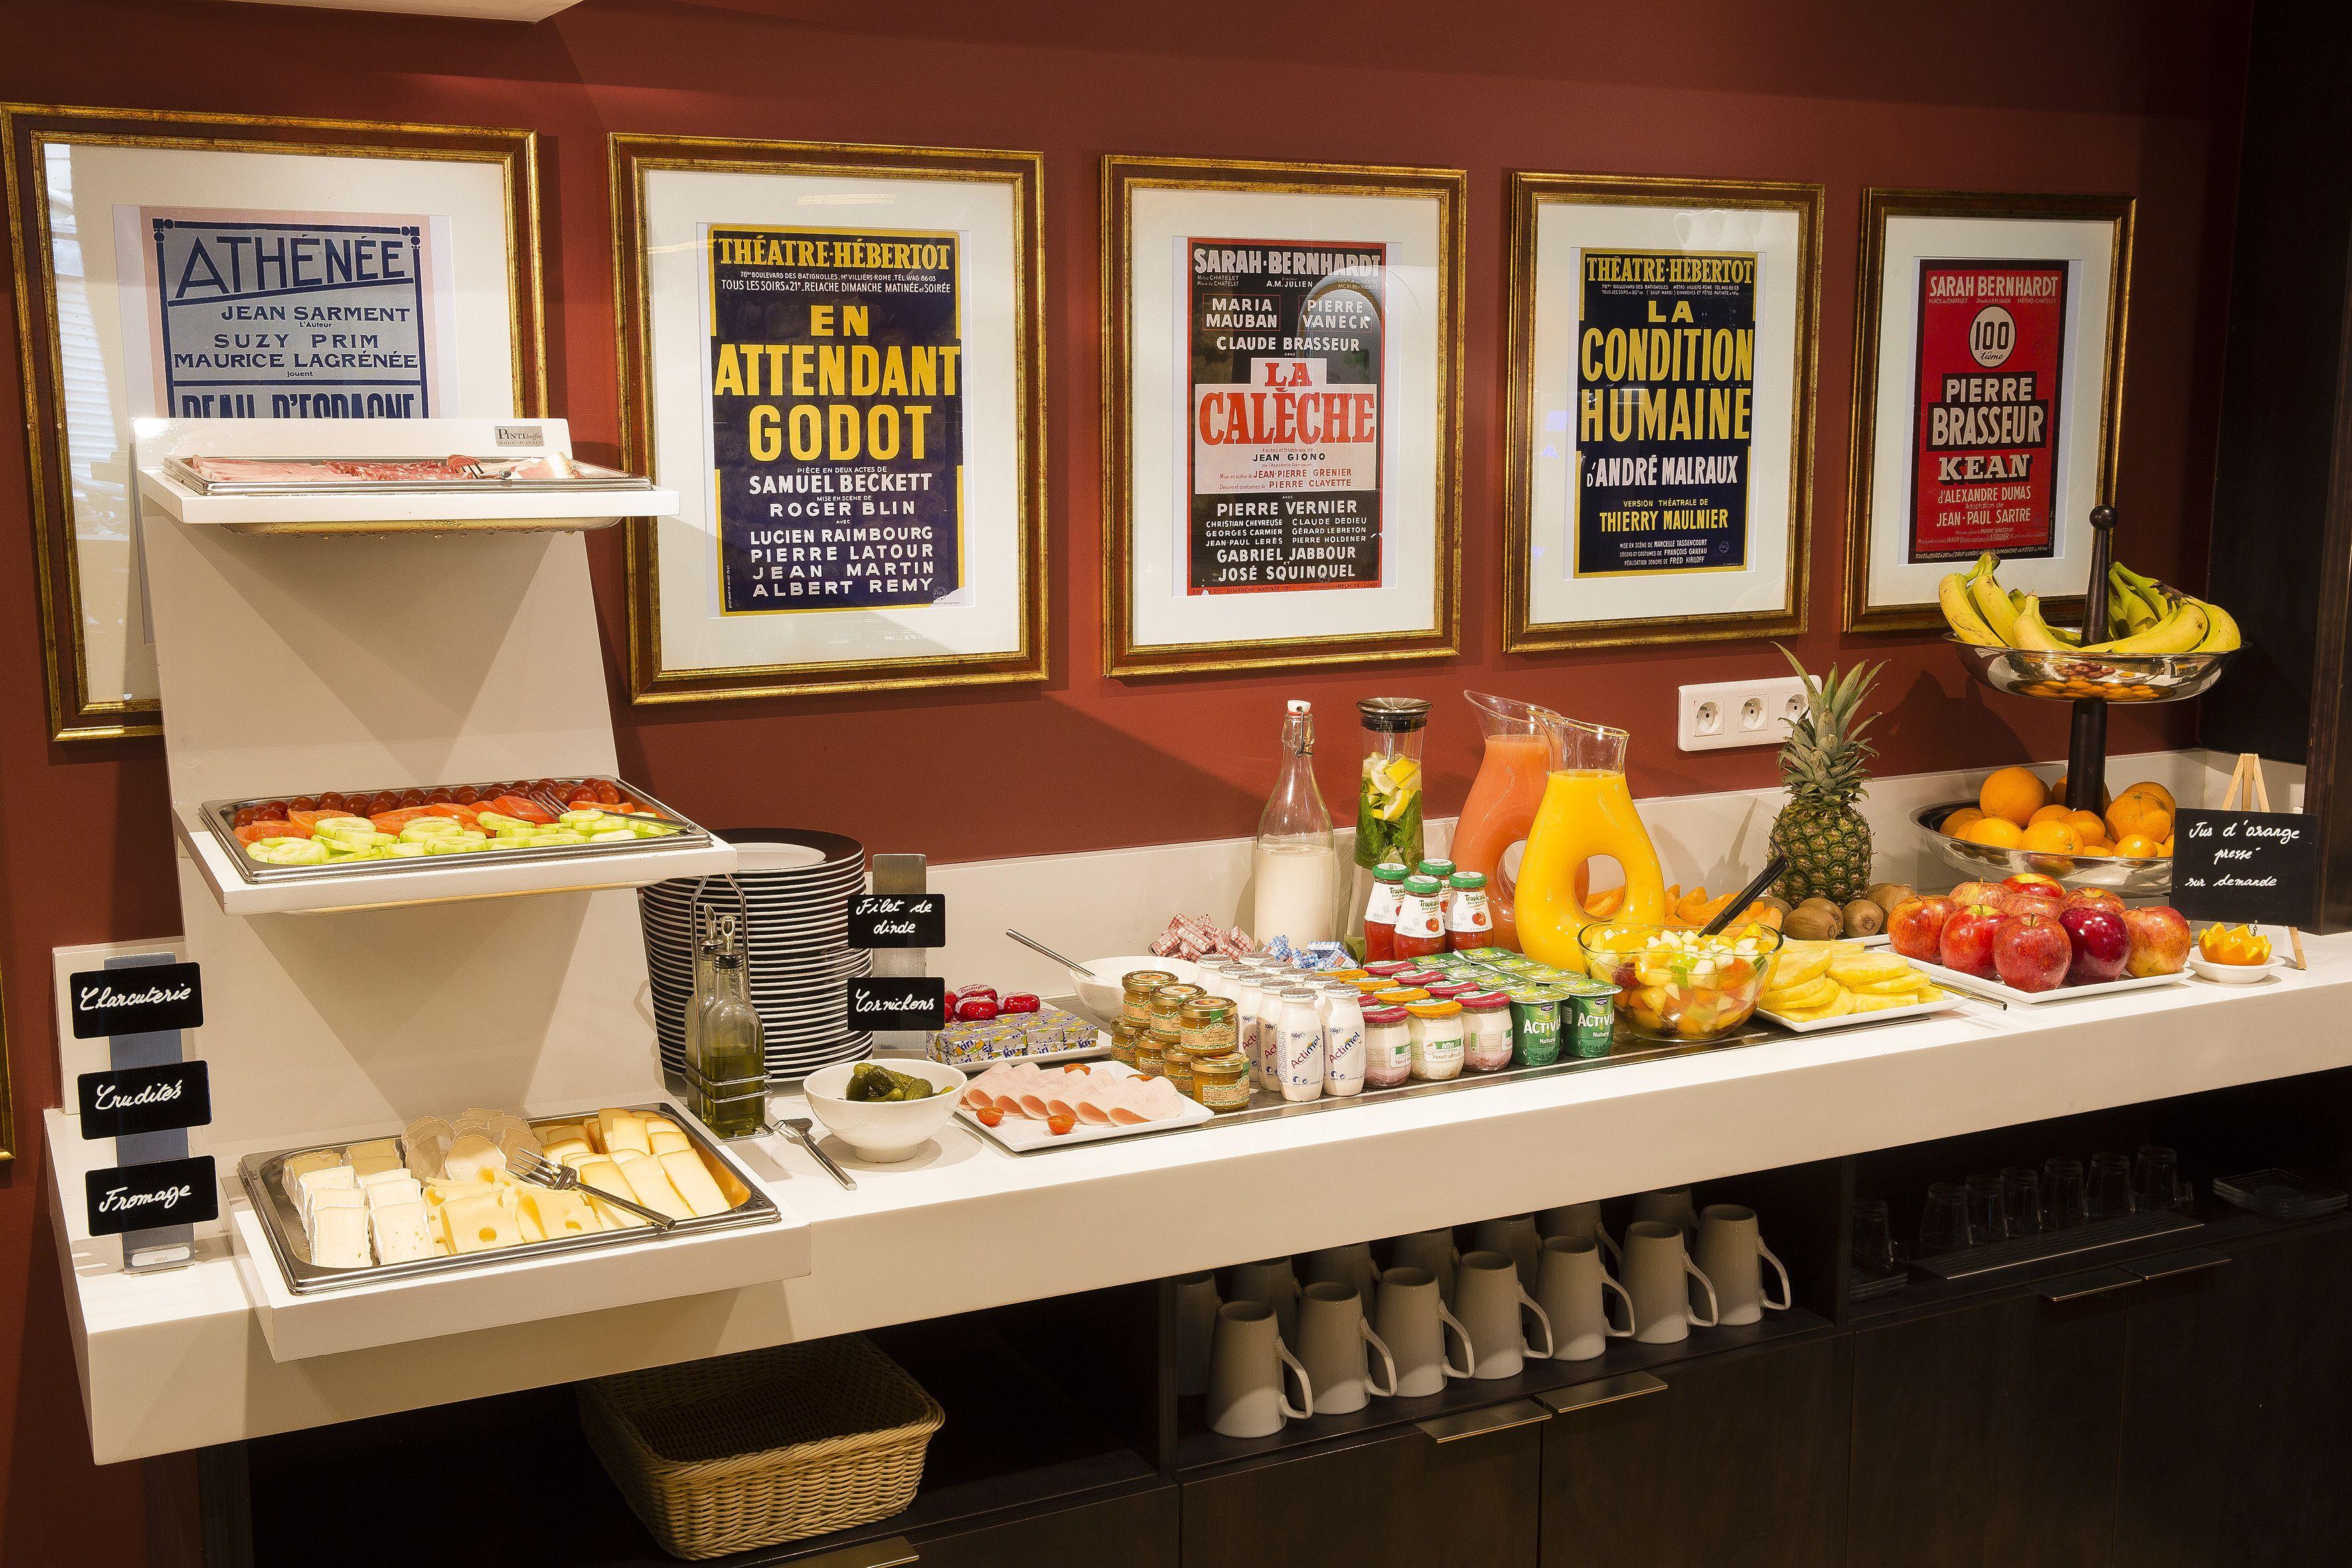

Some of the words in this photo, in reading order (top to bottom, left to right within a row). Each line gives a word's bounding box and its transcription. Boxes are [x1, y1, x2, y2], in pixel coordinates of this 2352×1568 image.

[175, 234, 406, 299] ATHÉNÉE
[722, 279, 744, 290] TOUS
[747, 281, 759, 290] LES
[761, 281, 785, 291] SOIRS
[841, 283, 882, 292] DIMANCHE
[885, 282, 919, 293] MATINÉE
[924, 282, 951, 293] SOIRÉE
[1930, 276, 1974, 297] SARAH
[1977, 276, 2058, 296] BERNHARDT
[221, 305, 285, 321] JEAN
[294, 306, 410, 322] SARMENT
[1212, 298, 1273, 311] MARIA
[1307, 299, 1363, 313] PIERRE
[1648, 301, 1693, 323] LA
[811, 305, 868, 337] EN
[1206, 314, 1277, 328] MAUBAN
[1302, 315, 1369, 329] VANECK
[214, 333, 290, 349] SUZY
[311, 334, 378, 349] PRIM
[1216, 336, 1276, 351] CLAUDE
[1283, 337, 1360, 351] BRASSEUR
[1974, 321, 2009, 351] 100
[174, 353, 285, 368] MAURICE
[294, 351, 420, 368] LAGRÉNÉE
[1582, 328, 1753, 381] CONDITION
[714, 343, 961, 396] ATTENDANT
[1265, 362, 1312, 387] LA
[1946, 377, 2033, 403] PIERRE
[1199, 387, 1375, 445] CALÈCHE
[1581, 388, 1751, 441] HUMAINE
[749, 404, 932, 461] GODOT
[1932, 406, 2044, 445] BRASSEUR
[1253, 453, 1280, 462] JEAN
[1287, 452, 1326, 461] GIONO
[1313, 468, 1352, 477] GRENIER
[1662, 455, 1738, 485] MALRAUX
[1938, 454, 2031, 481] KEAN
[749, 475, 834, 495] SAMUEL
[840, 473, 933, 493] BECKETT
[1269, 480, 1303, 489] PIERRE
[1309, 479, 1352, 487] CLAYETTE
[1659, 498, 1697, 507] THÉATRALE
[1938, 487, 1998, 504] d'ALEXANDRE
[2001, 485, 2031, 501] DUMAS
[769, 502, 852, 517] ROGER
[862, 501, 915, 516] BLIN
[1217, 502, 1279, 516] PIERRE
[1286, 500, 1358, 515] VERNIER
[1996, 508, 2031, 523] SARTRE
[1600, 511, 1658, 532] THIERRY
[1664, 509, 1728, 530] MAULNIER
[750, 528, 815, 545] LUCIEN
[821, 526, 933, 543] RAIMBOURG
[1293, 526, 1324, 535] GÉRARD
[751, 546, 837, 563] PIERRE
[850, 544, 933, 560] LATOUR
[1217, 548, 1283, 563] GABRIEL
[1289, 546, 1356, 561] JABBOUR
[752, 564, 823, 580] JEAN
[846, 561, 934, 578] MARTIN
[1218, 565, 1257, 582] JOSÉ
[1267, 564, 1356, 582] SQUINQUEL
[752, 580, 853, 597] ALBERT
[870, 578, 933, 593] REMY
[2189, 821, 2213, 838] Jus
[2185, 877, 2206, 887] sur
[2213, 874, 2278, 887] demande
[856, 898, 905, 915] Filet
[909, 900, 933, 913] de
[873, 919, 916, 935] dinde
[855, 988, 934, 1012] Cornichons
[1291, 1035, 1320, 1069] Actimel
[1328, 1030, 1361, 1064] Actimel
[99, 1185, 192, 1213] Fromage
